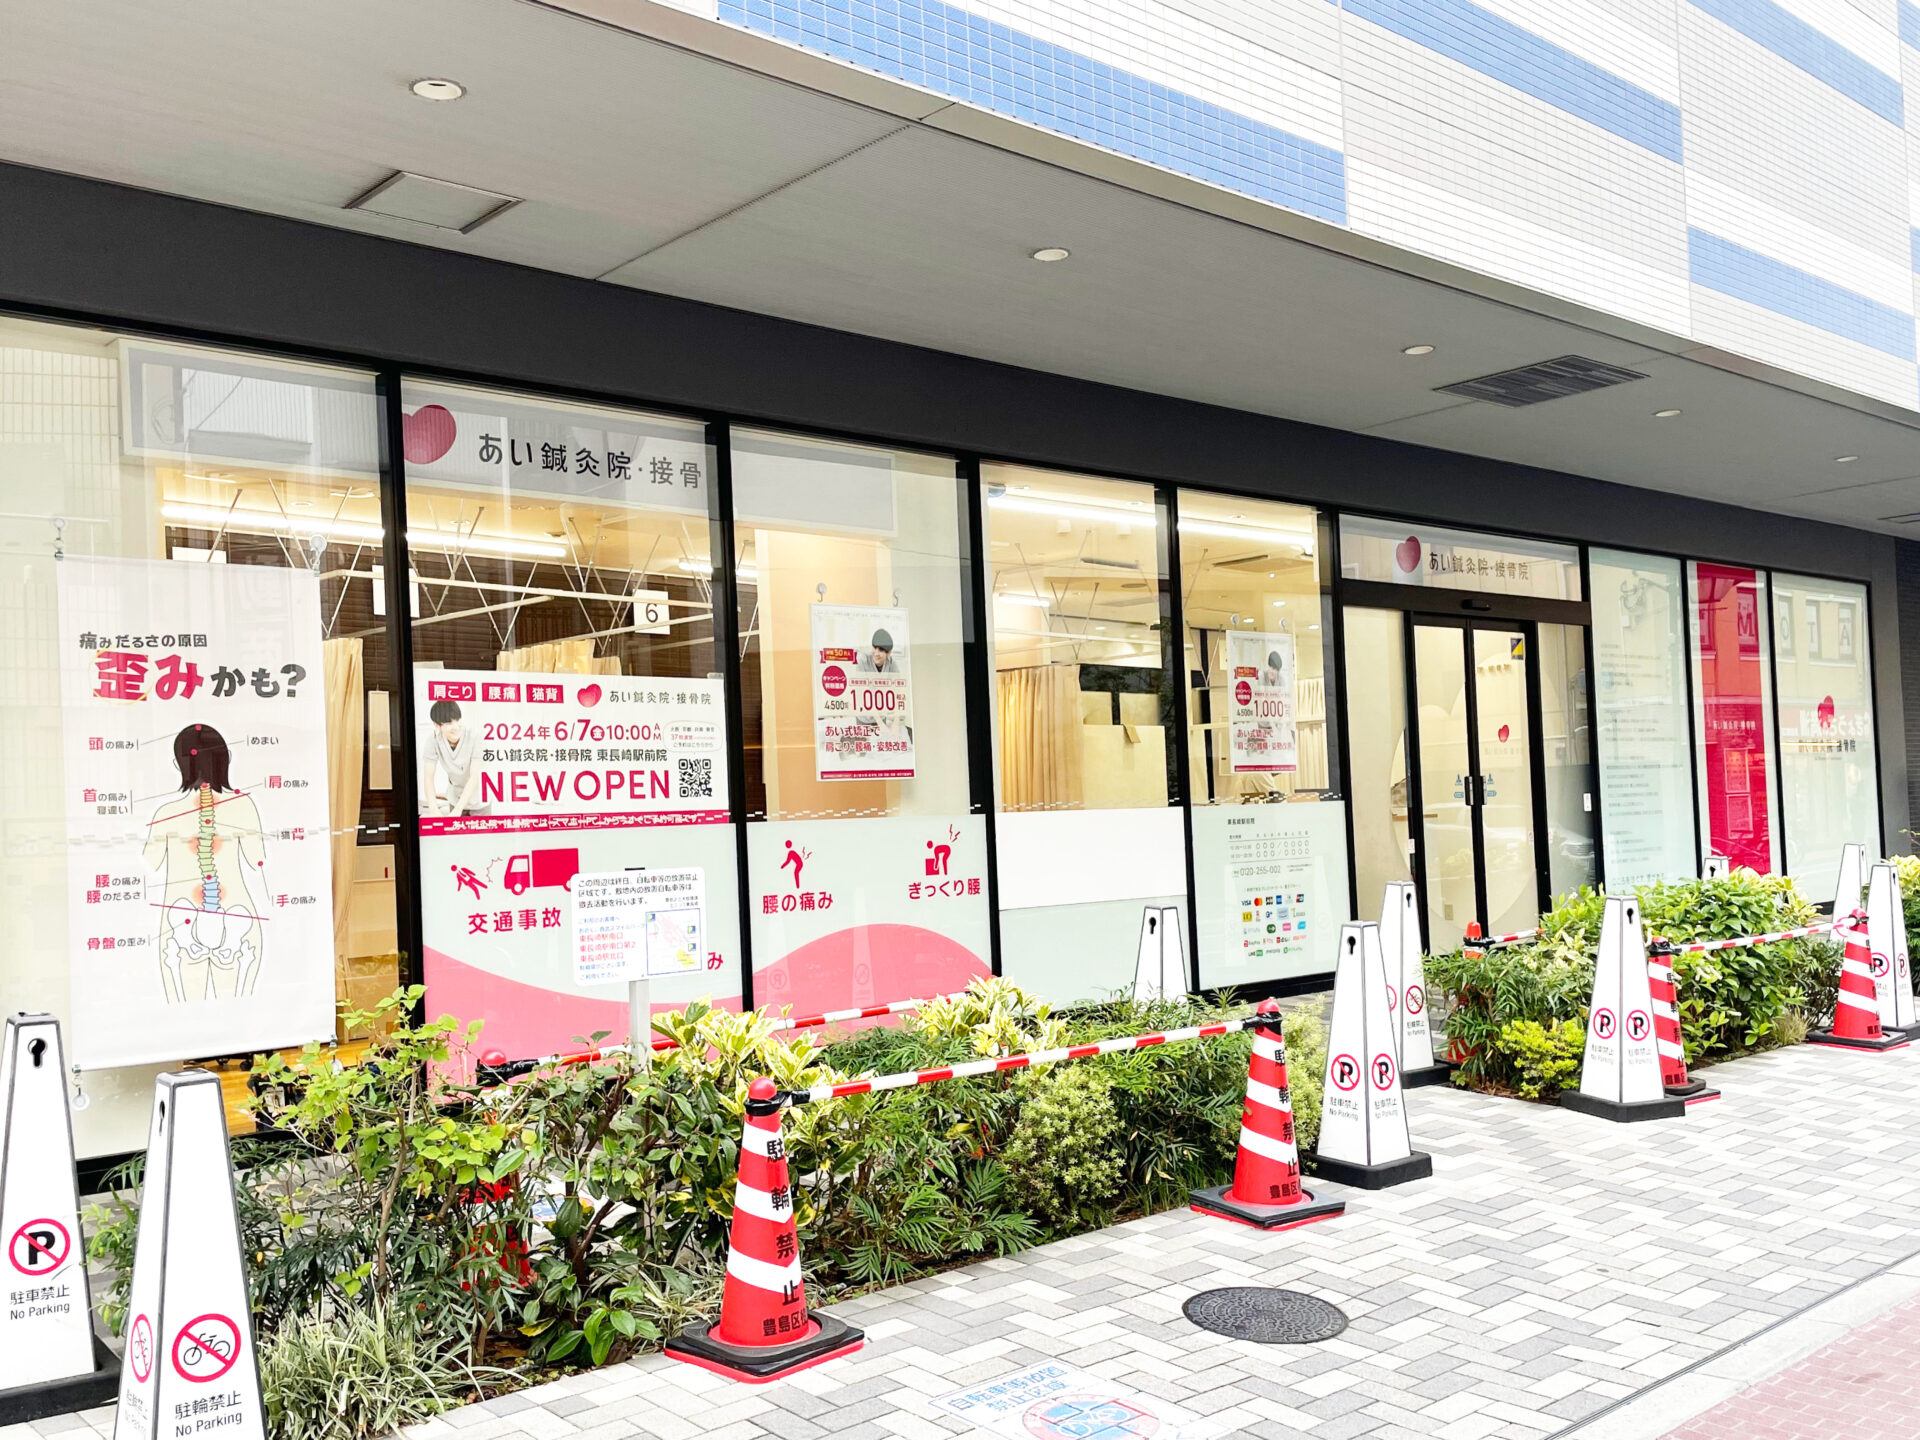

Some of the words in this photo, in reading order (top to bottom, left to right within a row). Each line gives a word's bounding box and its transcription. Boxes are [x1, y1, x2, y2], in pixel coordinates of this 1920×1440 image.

[478, 433, 702, 489] あい鍼灸院・接骨
[1429, 552, 1529, 580] あい鍼灸院・接骨院
[645, 603, 659, 623] 6
[79, 632, 208, 650] 痛みだるさの原因
[433, 684, 473, 701] 肩こり
[488, 684, 516, 701] 腰痛
[532, 686, 558, 702] 猫背
[609, 690, 712, 705] あい鍼灸院・接骨院
[850, 690, 895, 712] 1,000
[89, 737, 135, 751] 頭の痛み
[251, 736, 279, 745] めまい
[482, 748, 592, 763] あい鍼灸院・接骨院
[597, 748, 668, 762] 東長崎駅前院
[269, 775, 309, 789] 肩の痛み
[481, 770, 566, 803] NEW
[574, 769, 669, 802] OPEN
[83, 788, 127, 803] 首の痛み
[95, 874, 141, 888] 腰の痛み
[908, 878, 981, 900] ぎっくり腰
[86, 890, 142, 904] 腰のだるさ
[276, 894, 317, 908] 手の痛み
[762, 891, 834, 914] 腰の痛み
[468, 907, 562, 935] 交通事故
[87, 936, 146, 951] 骨盤の歪み
[1338, 1109, 1358, 1121] Parking
[1270, 1180, 1300, 1199] 豊島区
[766, 1138, 799, 1306] 駐輪禁止
[10, 1284, 70, 1305] 駐車禁止
[10, 1310, 25, 1320] No
[29, 1303, 70, 1317] Parking
[175, 1390, 242, 1420] 駐輪禁止
[176, 1425, 192, 1438] No
[196, 1412, 242, 1432] Parking
